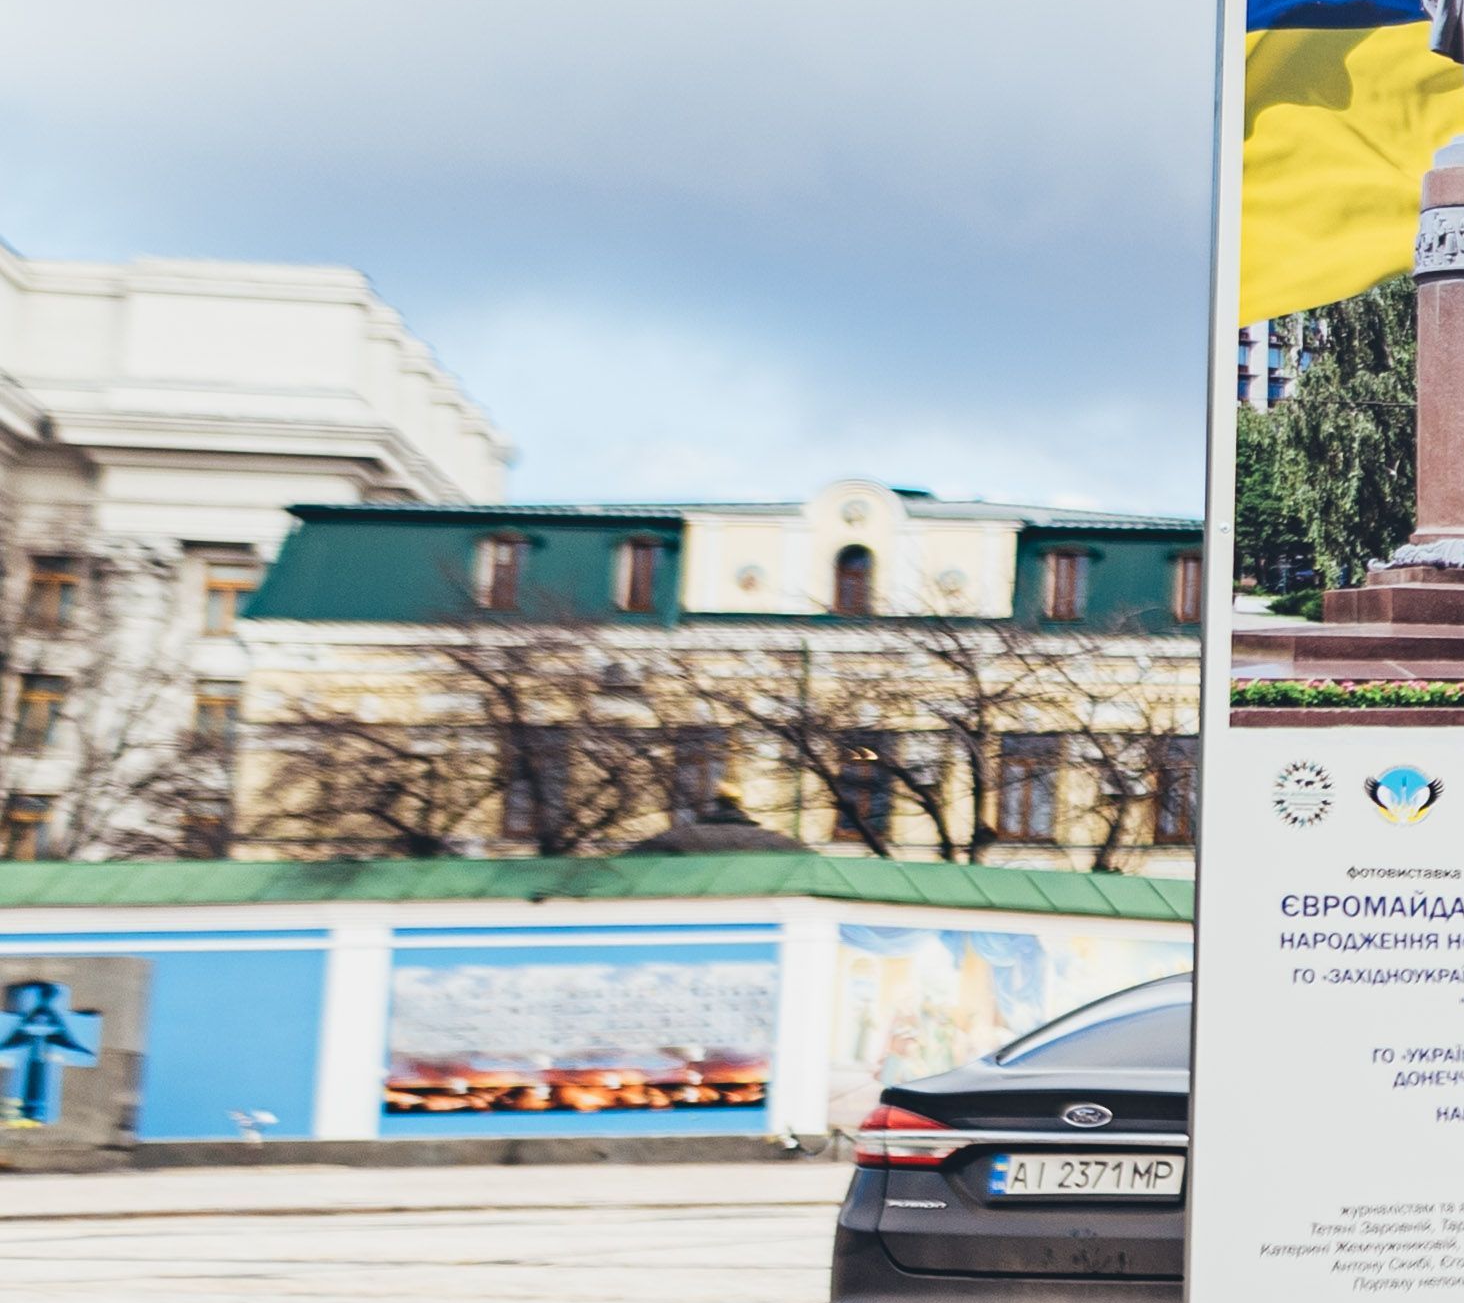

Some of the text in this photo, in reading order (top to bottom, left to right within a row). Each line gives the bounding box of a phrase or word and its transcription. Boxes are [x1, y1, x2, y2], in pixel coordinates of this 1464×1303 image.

[1347, 866, 1462, 880] фотовиставка
[1280, 932, 1439, 952] НАРОДЖЕННЯ
[1293, 968, 1315, 985] ГО
[1372, 1048, 1394, 1063] ГО
[1011, 1160, 1174, 1189] AI 2371 MP
